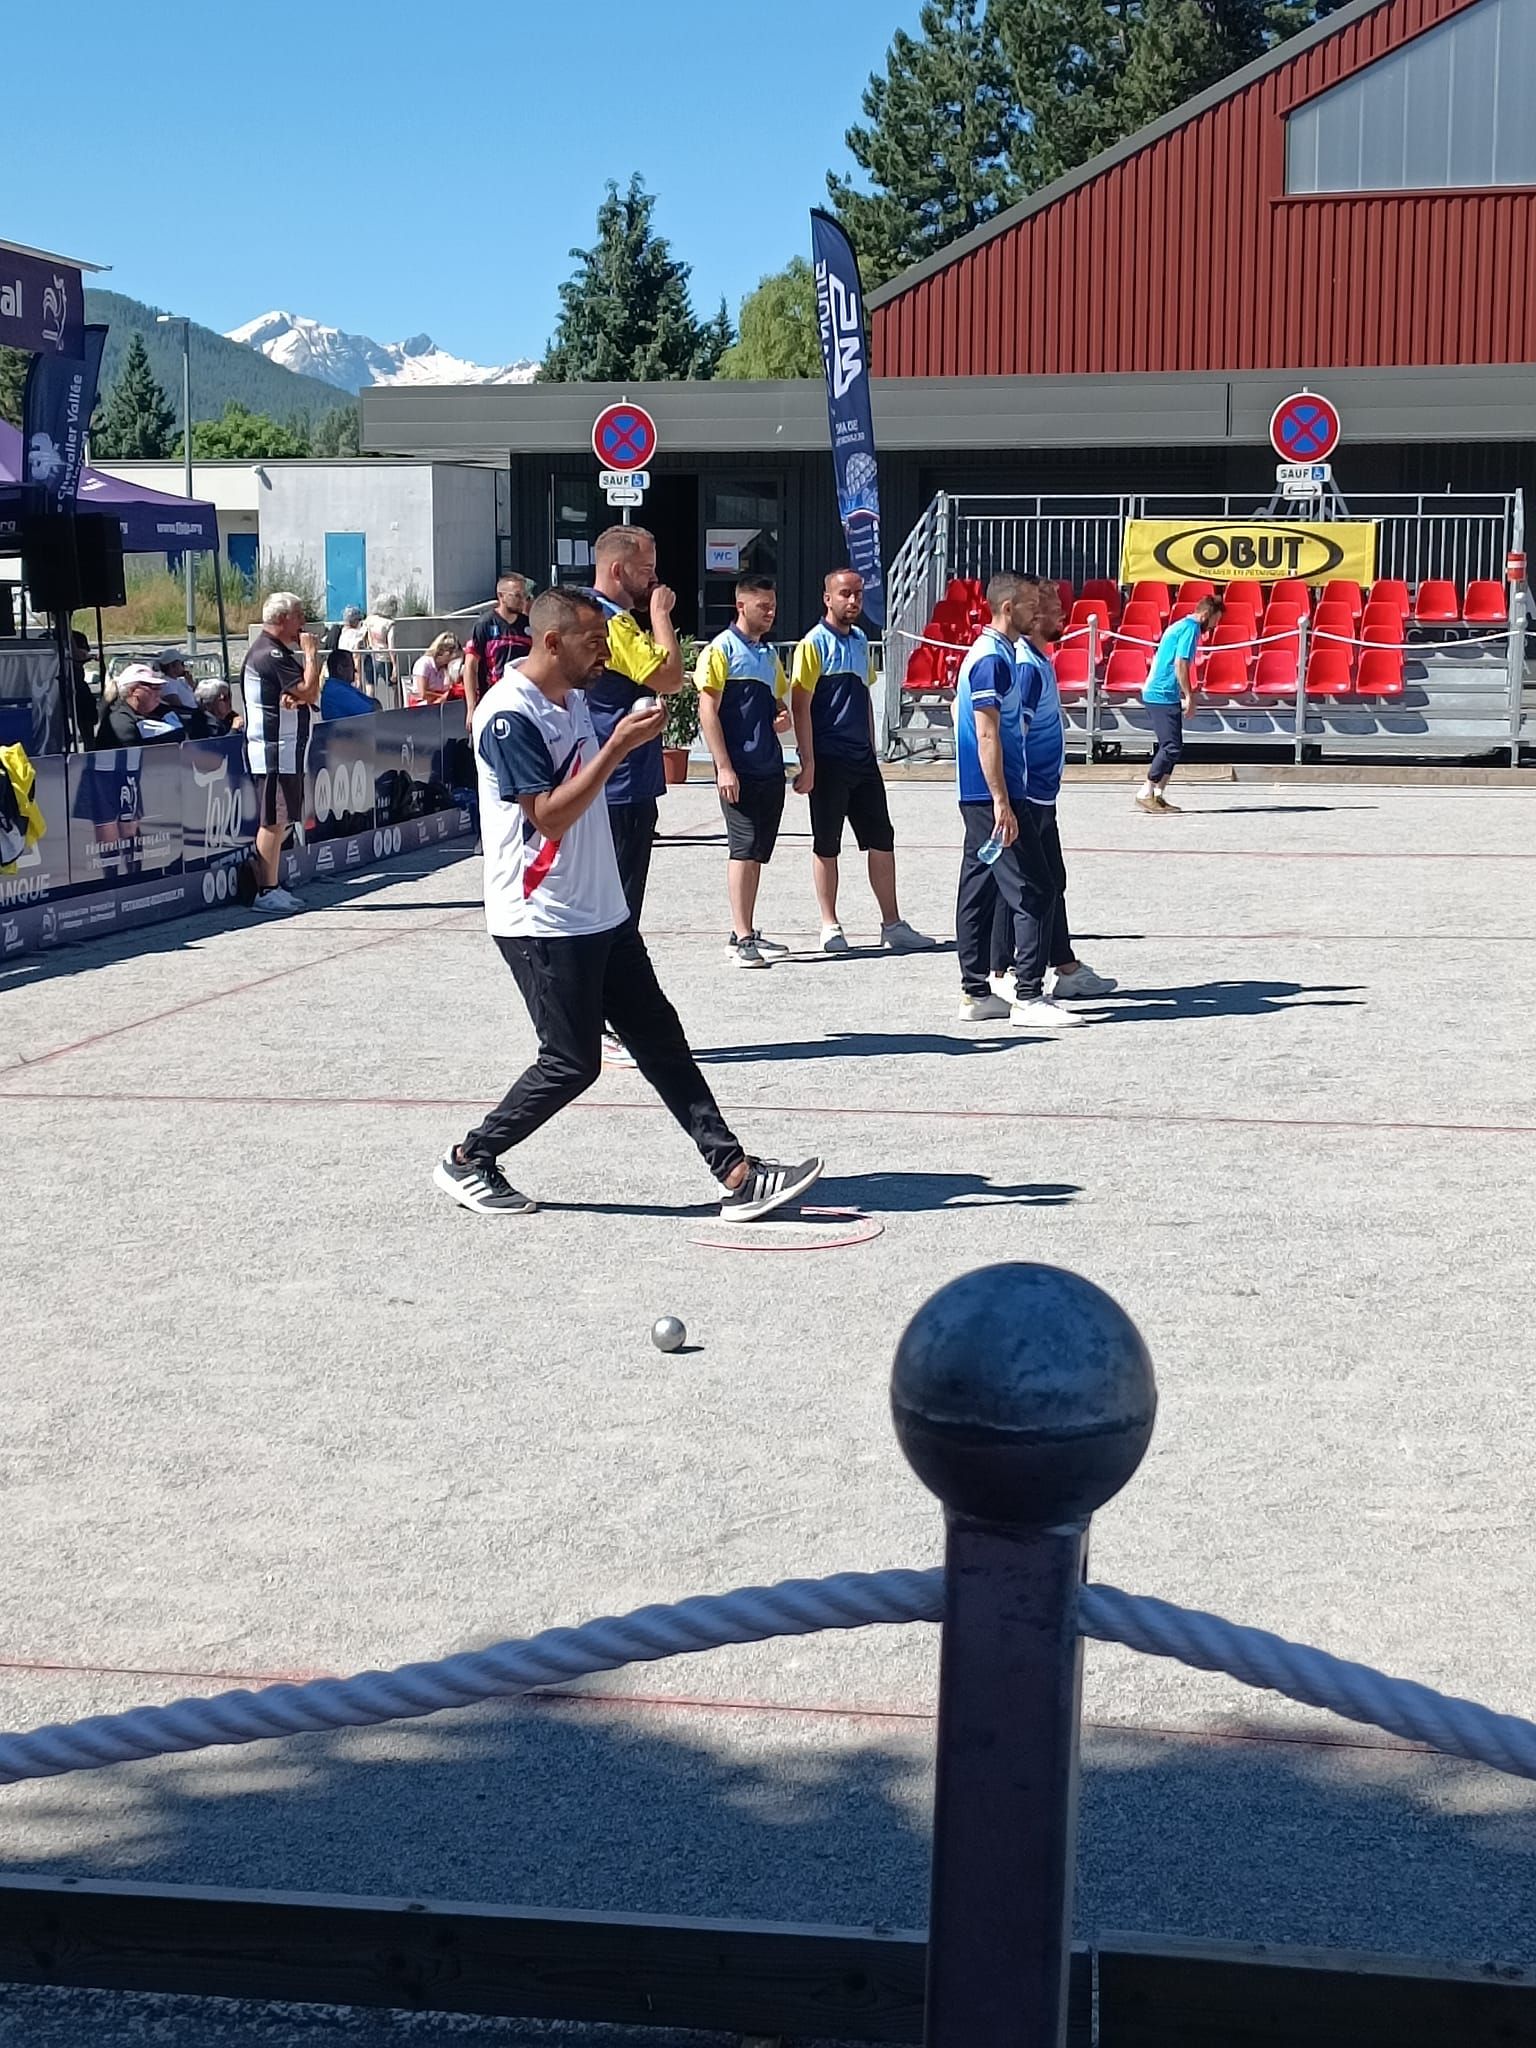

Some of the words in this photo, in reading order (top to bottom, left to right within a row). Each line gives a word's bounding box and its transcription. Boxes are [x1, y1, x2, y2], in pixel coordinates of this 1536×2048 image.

[1280, 468, 1309, 479] SAUF
[603, 475, 630, 486] SAUF
[713, 551, 733, 561] WC
[1193, 535, 1304, 569] OBUT
